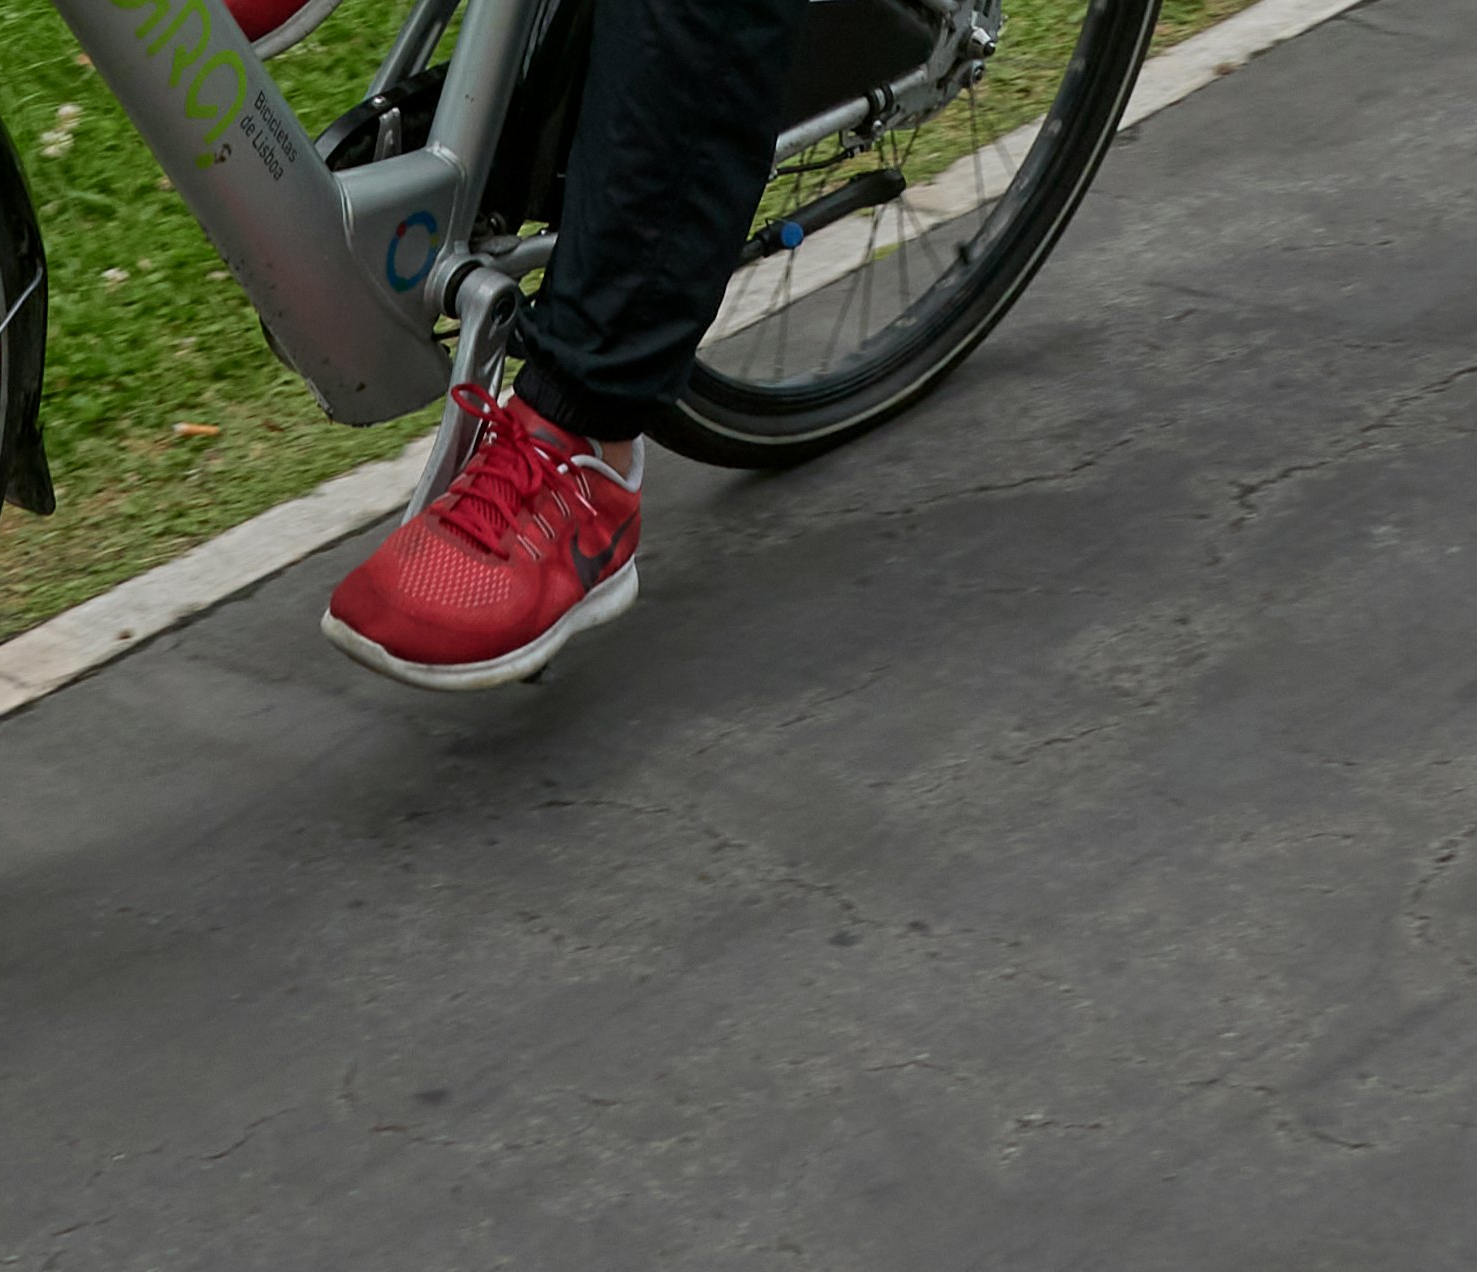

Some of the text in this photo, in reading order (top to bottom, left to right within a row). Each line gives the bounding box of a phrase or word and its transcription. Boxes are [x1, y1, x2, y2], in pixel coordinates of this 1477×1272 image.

[239, 115, 285, 181] de Lisboa
[254, 89, 298, 164] Bicicletas
